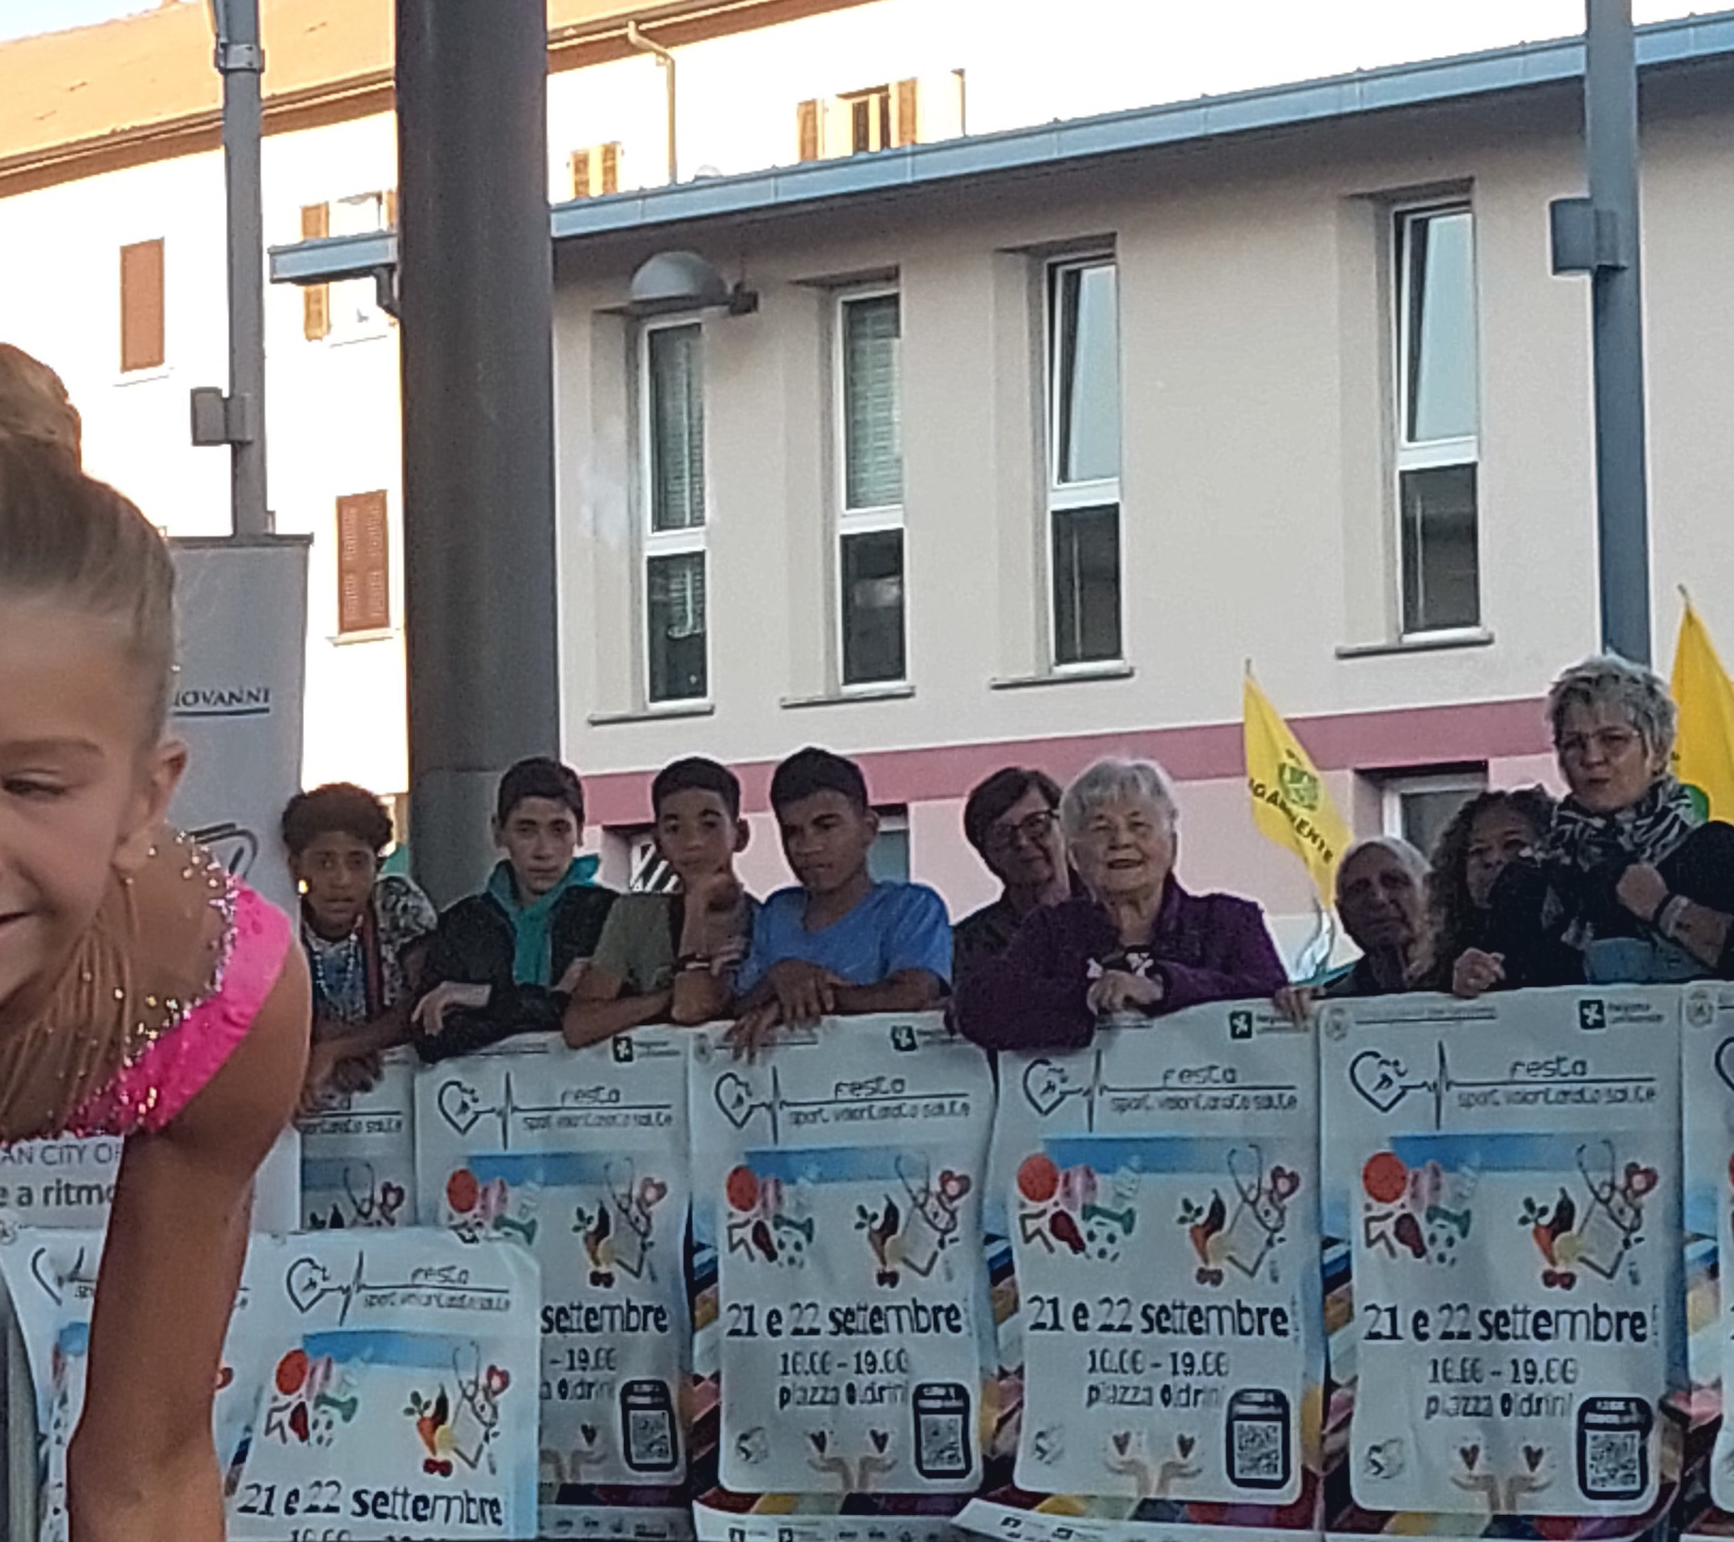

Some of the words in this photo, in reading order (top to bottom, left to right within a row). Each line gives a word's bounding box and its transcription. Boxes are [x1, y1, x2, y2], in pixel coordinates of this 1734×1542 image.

[40, 1143, 87, 1166] CITY
[16, 1186, 33, 1207] a
[541, 1298, 668, 1334] settembre
[726, 1302, 759, 1337] 21
[766, 1308, 783, 1337] e
[790, 1301, 822, 1337] 22
[828, 1298, 963, 1335] settembre
[1027, 1296, 1065, 1332] 21
[1072, 1300, 1089, 1332] e
[1097, 1296, 1133, 1333] 22
[1140, 1298, 1290, 1338] settembre
[1363, 1302, 1403, 1341] 21
[1412, 1308, 1430, 1342] e
[1438, 1302, 1472, 1341] 22
[1478, 1302, 1648, 1343] settembre
[237, 1482, 276, 1517] 21
[284, 1488, 301, 1516] e
[303, 1480, 342, 1514] 22
[350, 1485, 504, 1526] settembre
